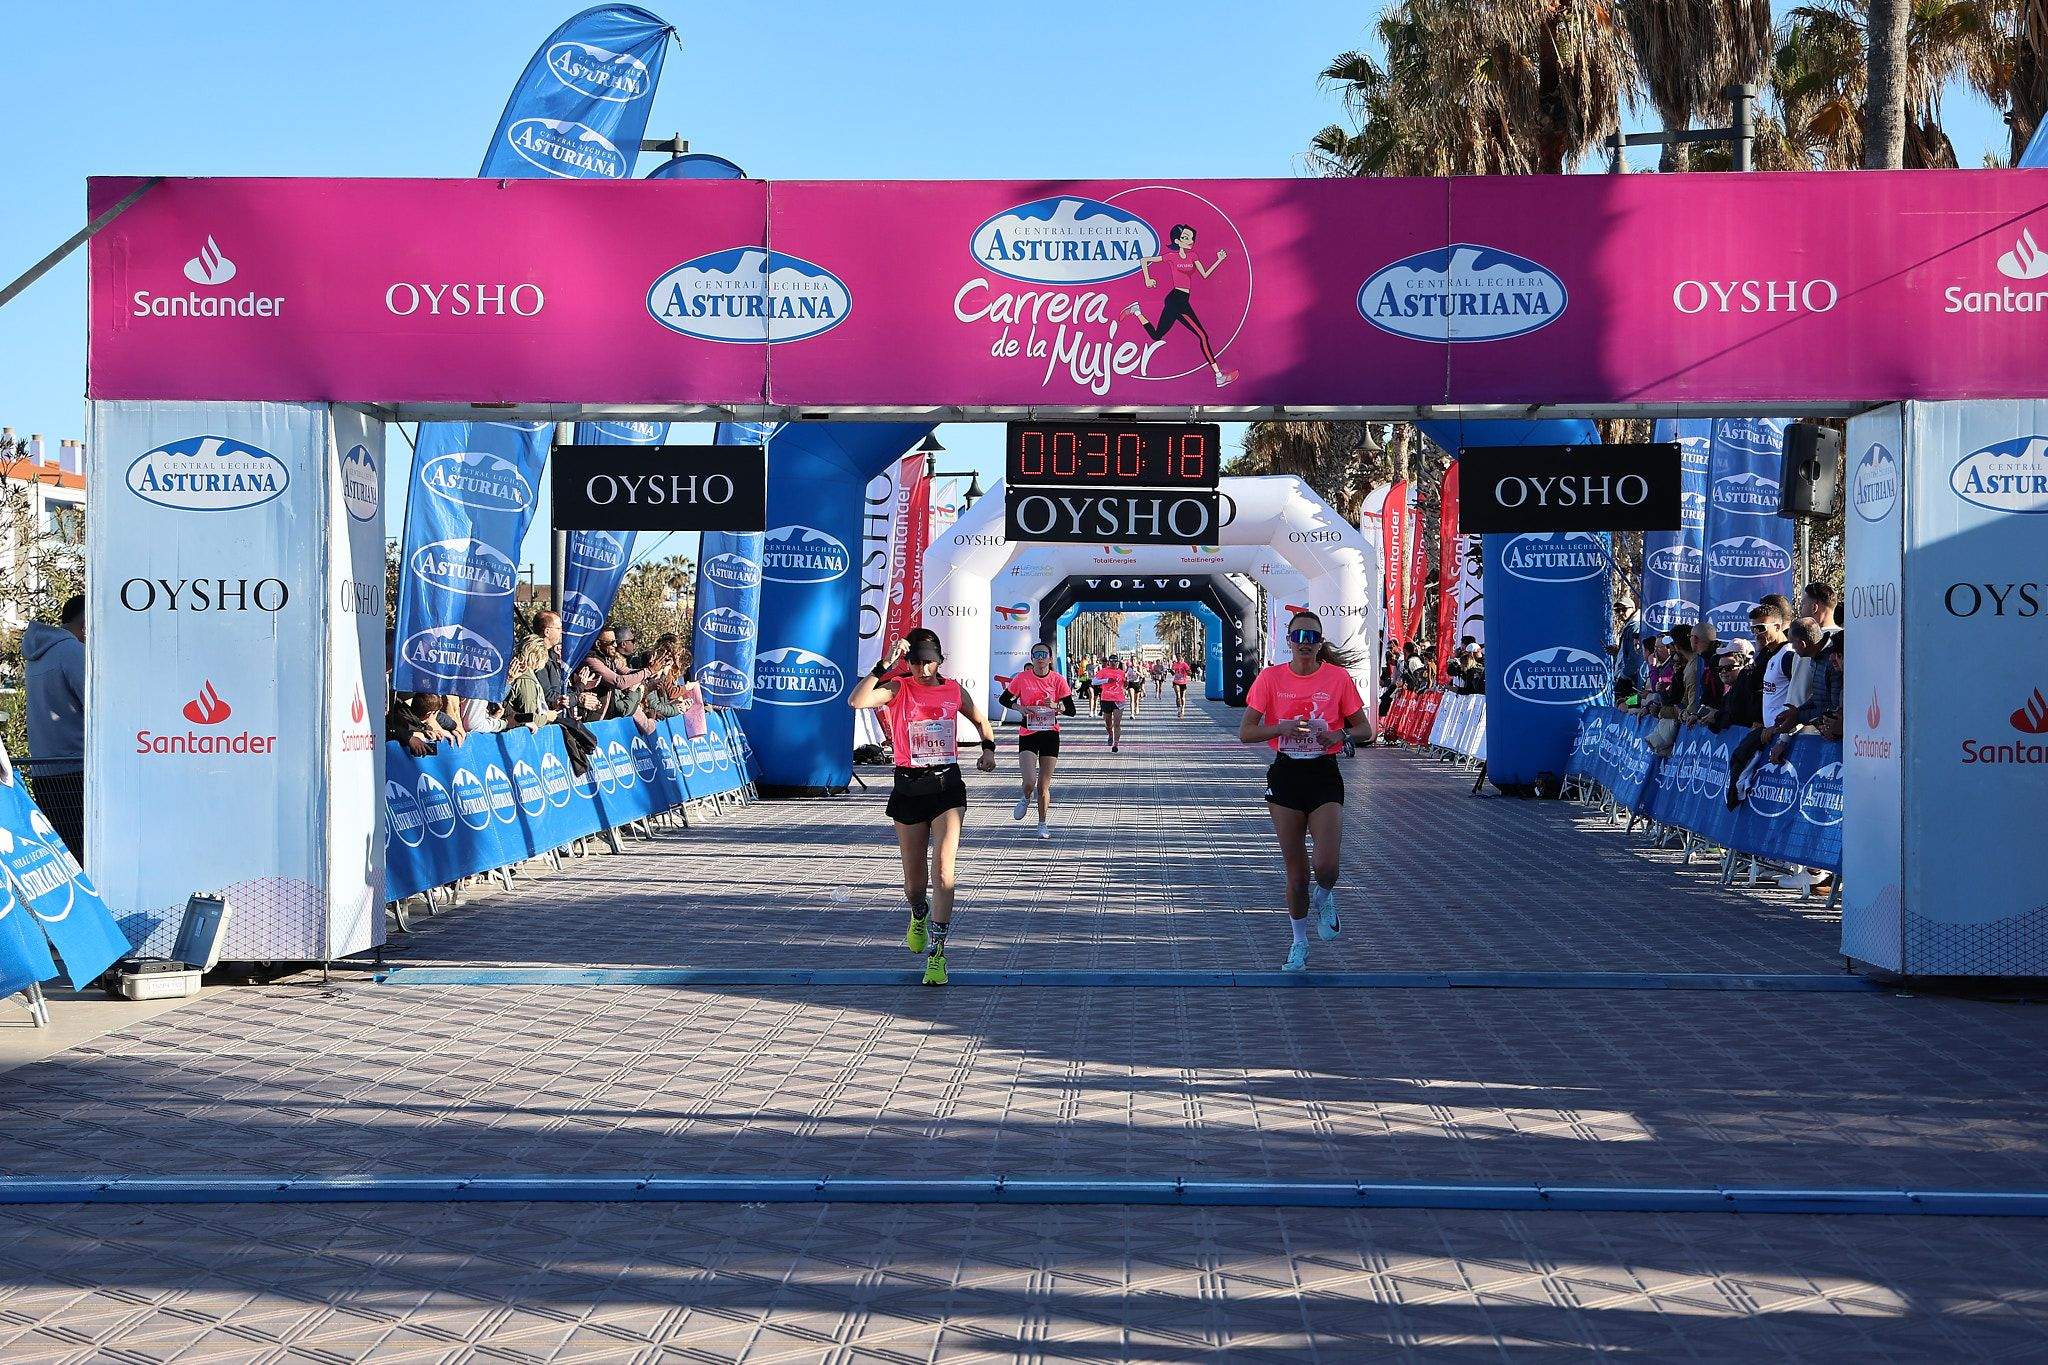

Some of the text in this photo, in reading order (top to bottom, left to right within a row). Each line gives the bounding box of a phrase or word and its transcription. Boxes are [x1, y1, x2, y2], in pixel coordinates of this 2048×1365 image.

[515, 126, 616, 178] ASTURIANA
[985, 228, 1145, 261] ASTURIANA
[1015, 226, 1140, 236] CENTRAL LECHERA
[694, 280, 830, 291] CENTRAL LECHERA
[1406, 277, 1544, 289] CENTRAL LECHERA
[1672, 279, 1839, 313] OYSHO
[134, 290, 285, 318] Santander
[385, 282, 545, 317] OYSHO
[663, 282, 836, 319] ASTURIANA
[953, 277, 1109, 325] Carrera
[1374, 281, 1551, 318] ASTURIANA
[991, 320, 1167, 396] de la Mujer
[164, 462, 273, 470] CENTRAL LECHERA
[1021, 431, 1205, 478] 00:30:18
[1988, 463, 2043, 471] CENTRAL
[138, 463, 278, 493] ASTURIANA
[586, 474, 734, 505] OYSHO
[1495, 474, 1649, 508] OYSHO
[1016, 495, 1210, 538] OYSHO
[954, 534, 1006, 547] OYSHO
[1288, 530, 1342, 543] OYSHO
[1389, 508, 1400, 592] Santander
[419, 552, 512, 590] ASTURIANA
[858, 471, 893, 640] OYSHO
[1094, 557, 1137, 565] TotalEnergies
[1181, 556, 1224, 564] TotalEnergies
[120, 578, 289, 612] OYSHO
[341, 579, 379, 617] OYSHO
[1086, 578, 1191, 589] VOLVO
[929, 605, 978, 617] OYSHO
[1319, 605, 1369, 617] OYSHO
[1851, 582, 1896, 619] OYSHO
[1944, 582, 2048, 618] OYS
[758, 666, 796, 674] CENTRAL
[136, 729, 277, 755] Santander
[1854, 734, 1892, 759] Santander
